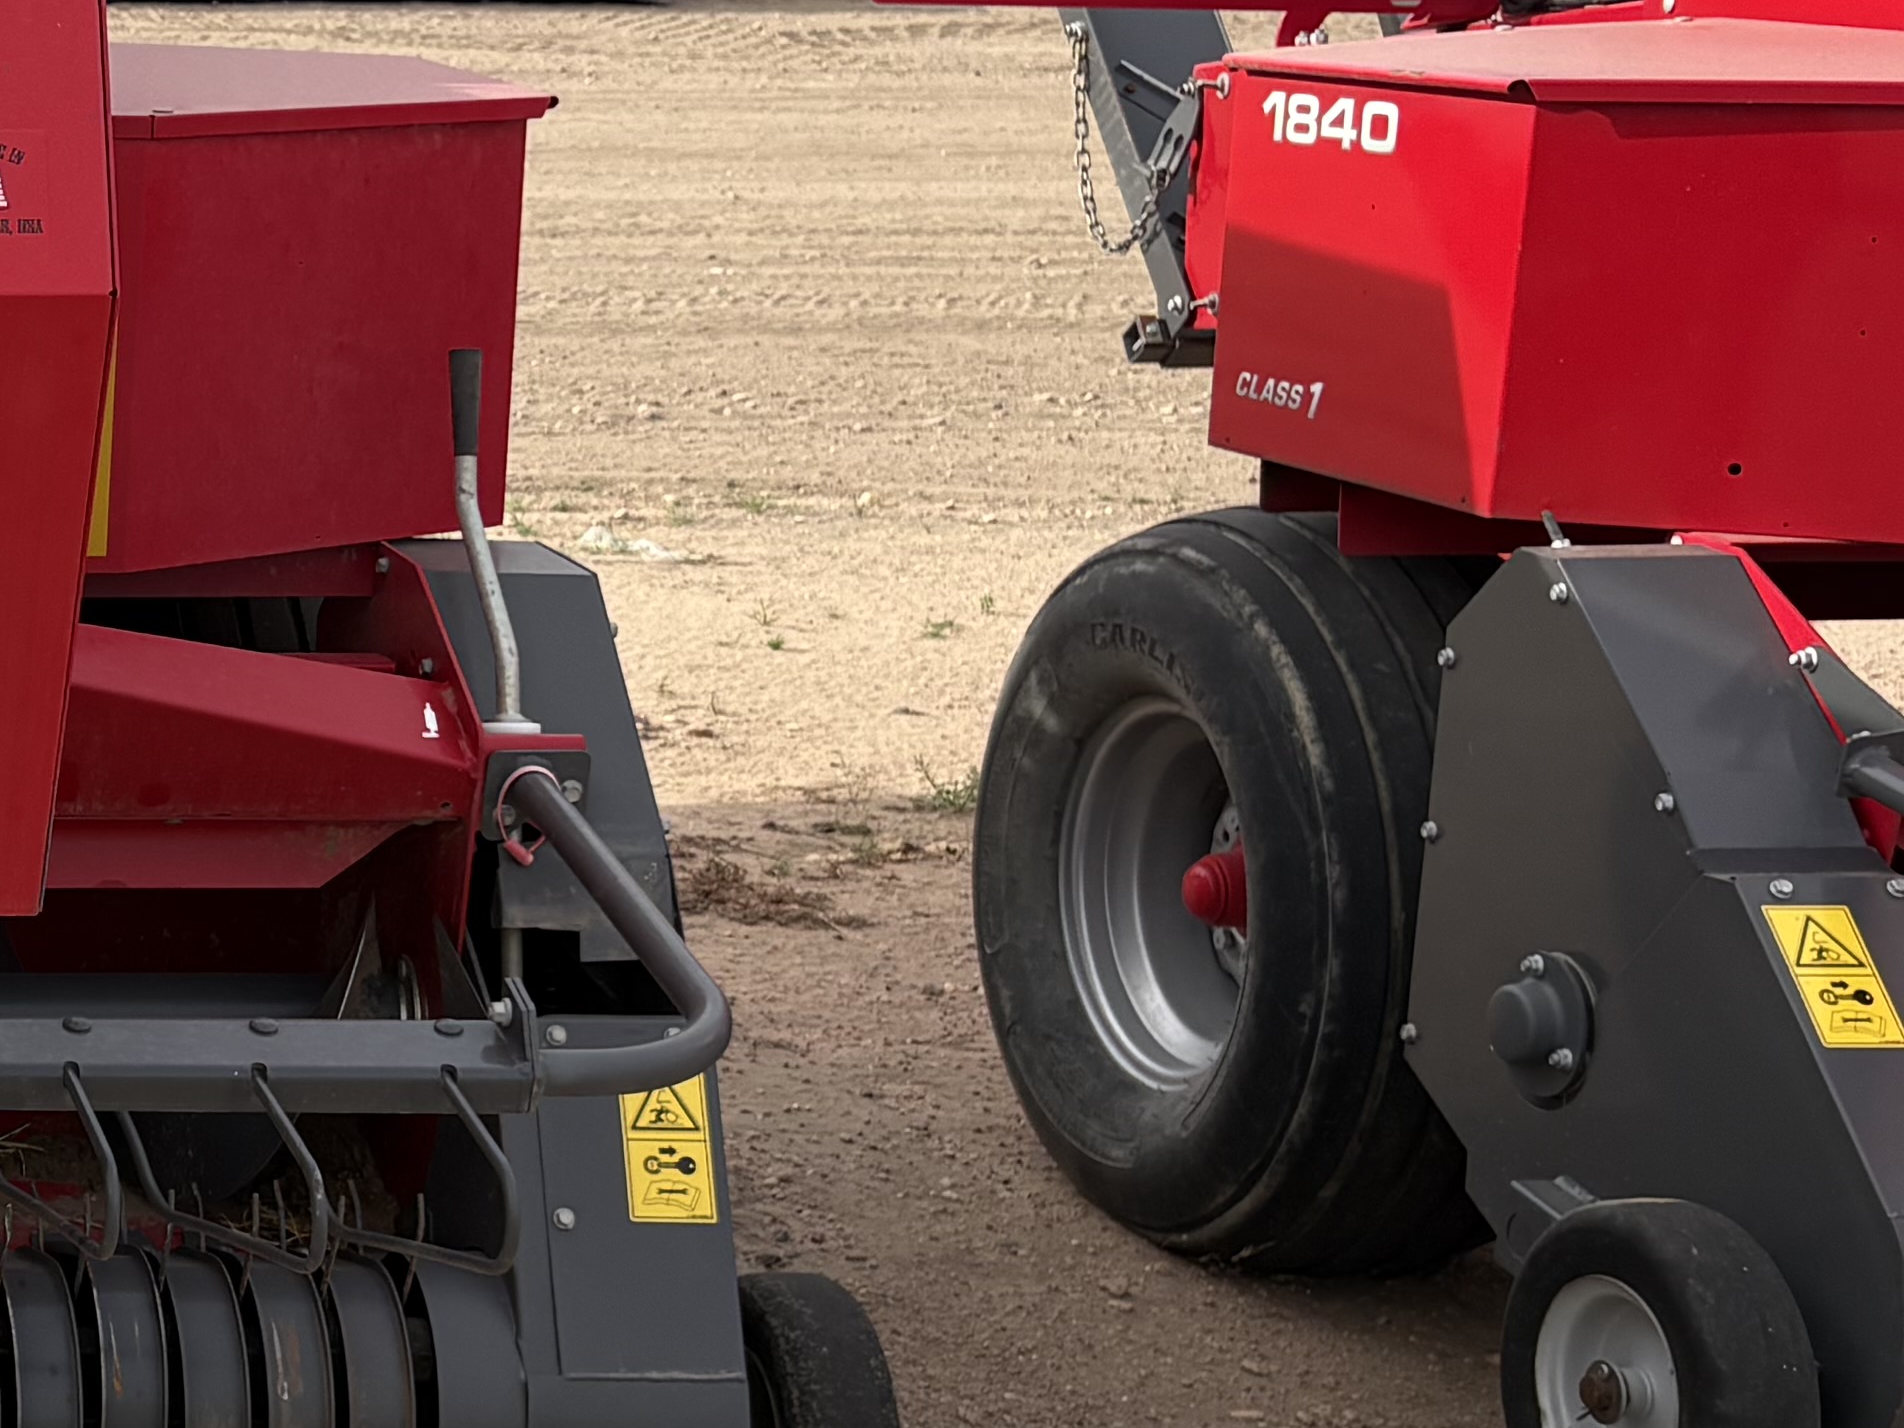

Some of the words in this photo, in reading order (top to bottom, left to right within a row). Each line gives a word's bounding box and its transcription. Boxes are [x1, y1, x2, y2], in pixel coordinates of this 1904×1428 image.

[1262, 90, 1399, 154] 1840
[8, 147, 26, 165] IN
[18, 218, 43, 234] USA
[1235, 371, 1304, 411] CLASS
[1307, 382, 1325, 420] 1
